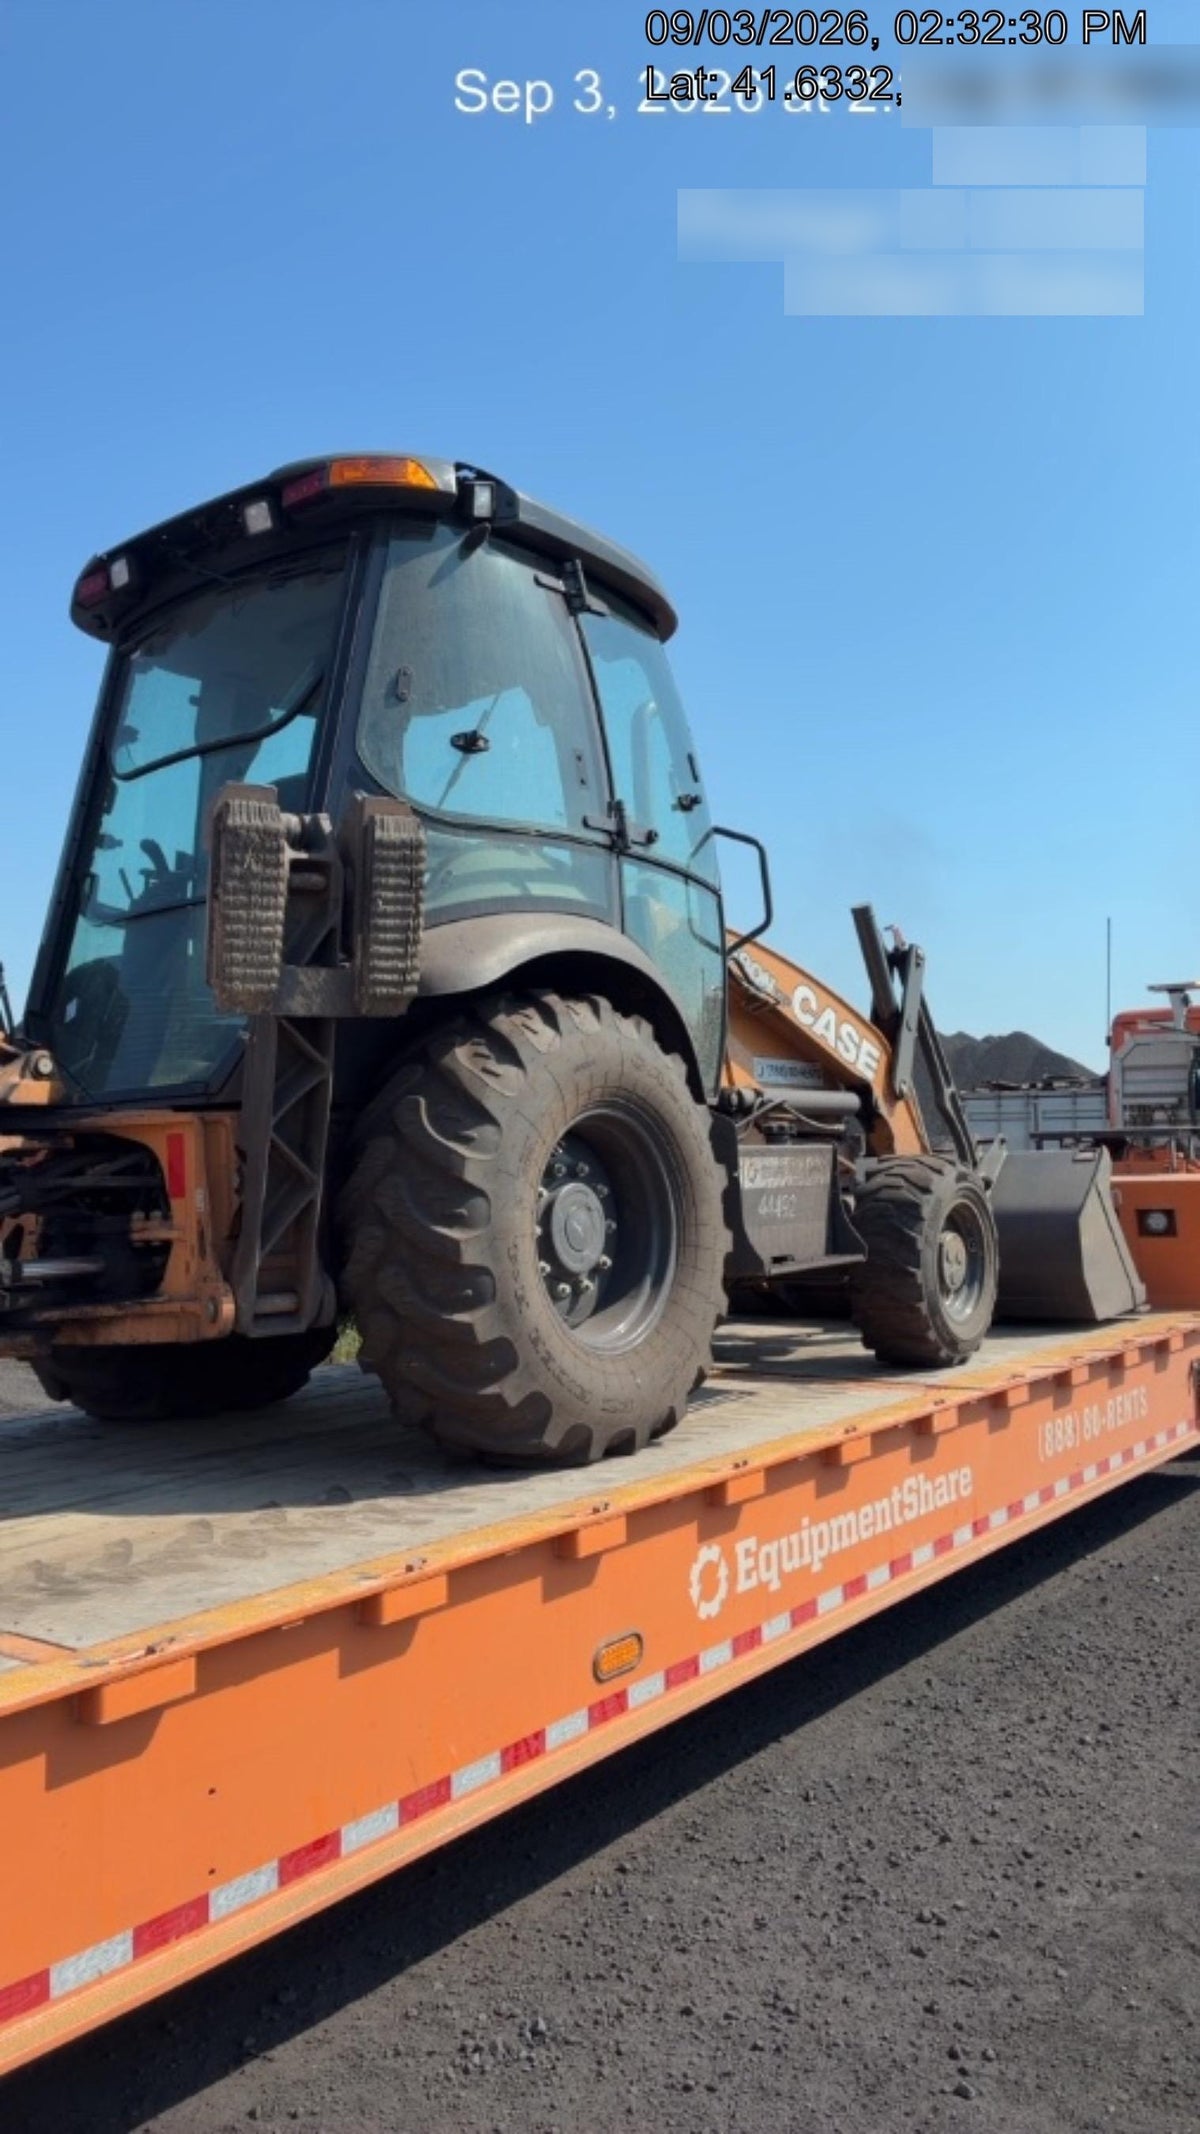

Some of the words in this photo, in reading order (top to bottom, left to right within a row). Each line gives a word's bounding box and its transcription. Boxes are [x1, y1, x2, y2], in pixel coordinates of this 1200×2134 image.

[792, 984, 881, 1082] CASE
[1038, 1409, 1079, 1462] (888)
[734, 1466, 972, 1593] EquipmentShare
